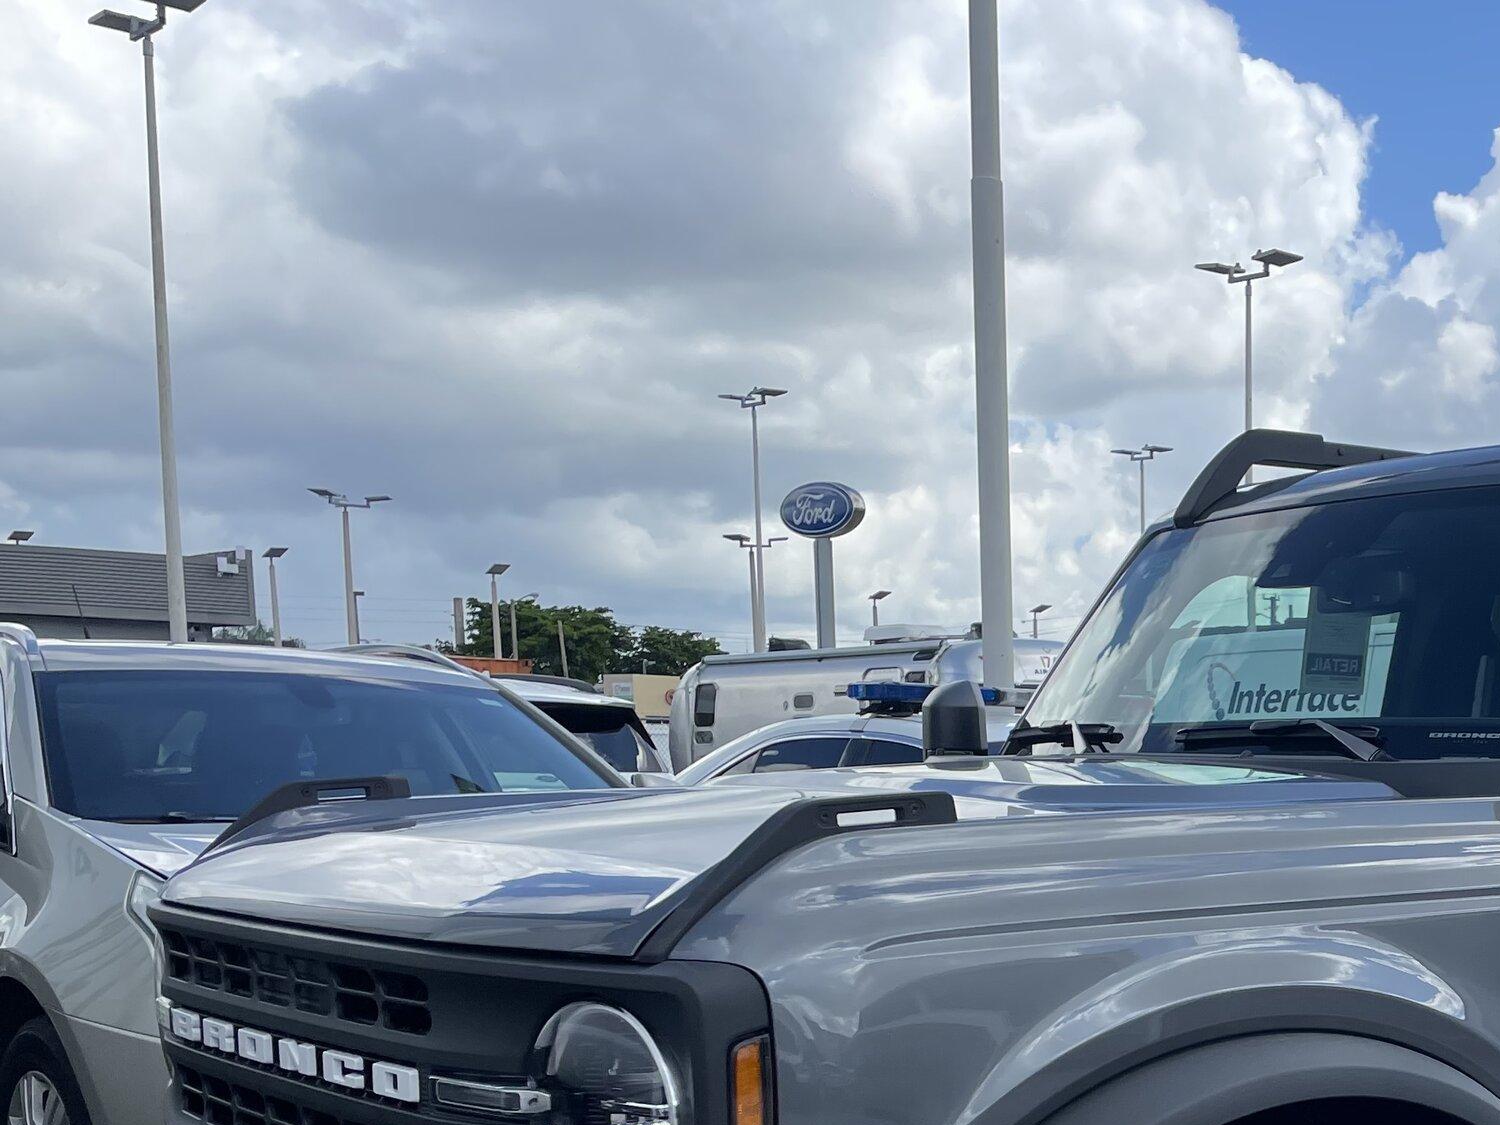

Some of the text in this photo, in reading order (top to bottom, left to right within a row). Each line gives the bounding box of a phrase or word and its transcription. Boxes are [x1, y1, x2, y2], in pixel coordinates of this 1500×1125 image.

[793, 493, 835, 525] Ford
[1227, 681, 1360, 714] Interface
[170, 1006, 420, 1103] BRONCO
